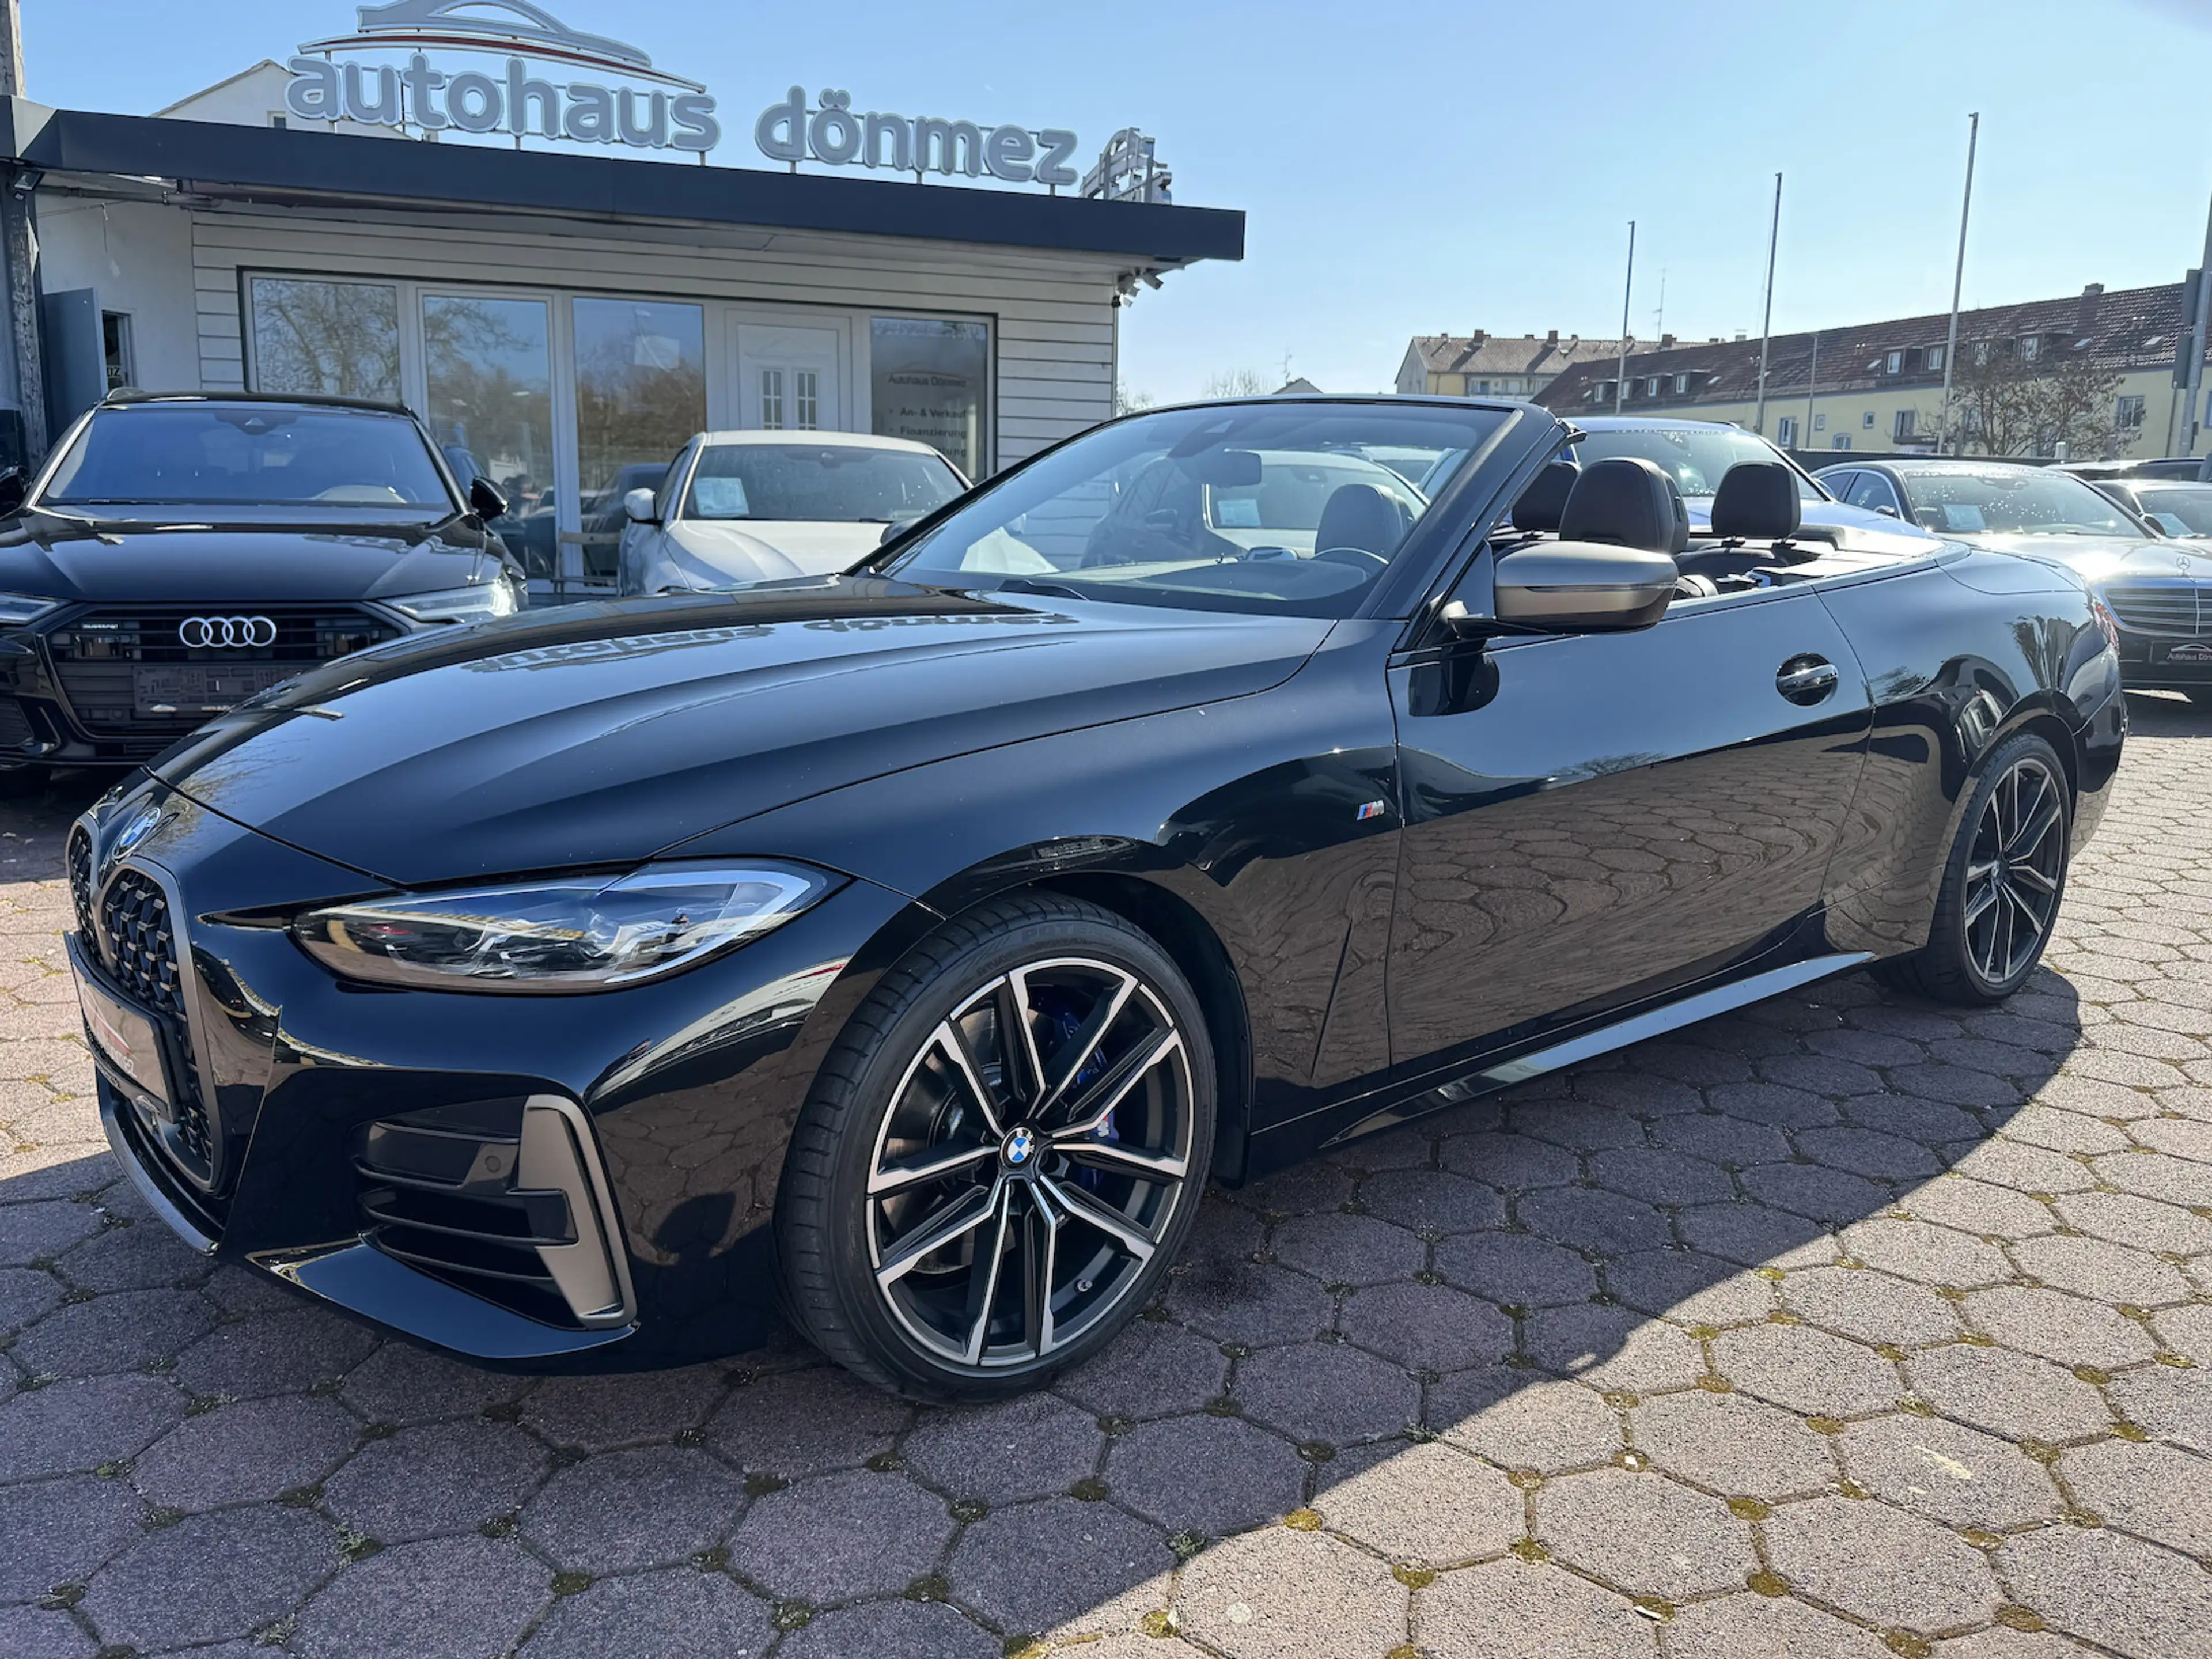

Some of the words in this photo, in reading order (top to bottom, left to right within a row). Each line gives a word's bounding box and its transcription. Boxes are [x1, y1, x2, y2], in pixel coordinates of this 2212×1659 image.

[285, 54, 721, 152] autohaus
[756, 86, 1077, 185] dönmez
[900, 407, 918, 417] An-
[920, 407, 927, 417] &
[929, 407, 966, 418] Verkauf
[900, 426, 967, 439] Finanzierung
